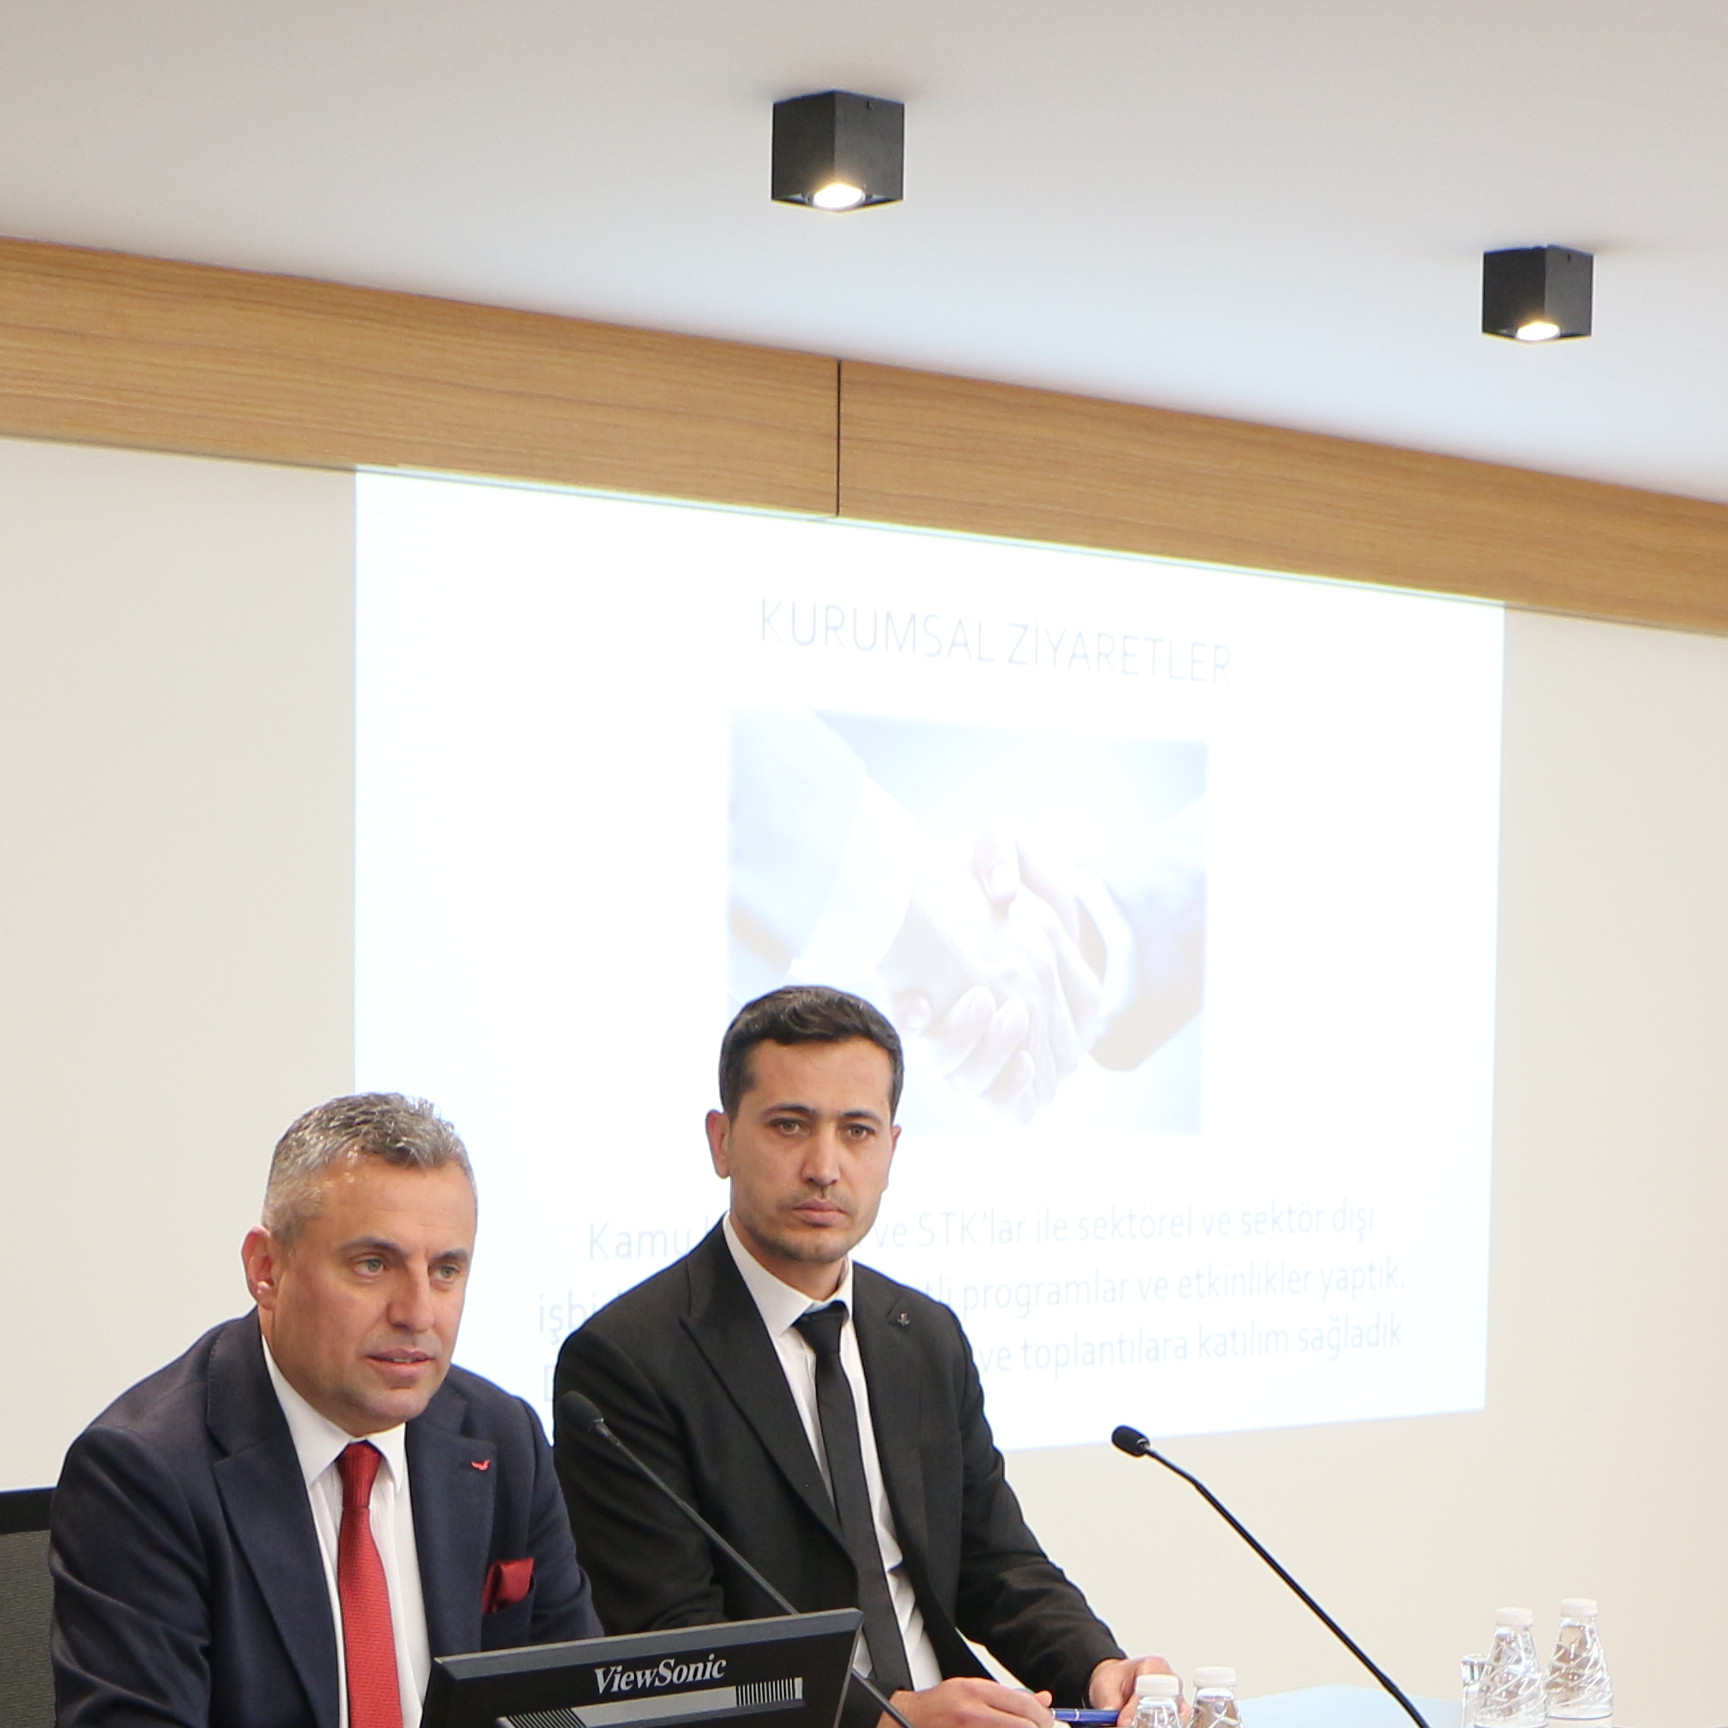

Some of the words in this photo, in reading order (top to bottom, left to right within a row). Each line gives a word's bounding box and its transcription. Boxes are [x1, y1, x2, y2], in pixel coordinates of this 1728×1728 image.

[761, 598, 995, 663] KURUMSAL
[1008, 615, 1231, 684] ZİYARETLER
[874, 1224, 907, 1249] ve
[917, 1209, 1026, 1247] STK'lar
[1036, 1206, 1067, 1244] ile
[1078, 1202, 1191, 1243] sektörel
[1201, 1214, 1232, 1238] ve
[1240, 1200, 1323, 1237] sektör
[1332, 1196, 1374, 1243] dışı
[963, 1265, 1128, 1322] programlar
[1138, 1277, 1168, 1301] ve
[1178, 1258, 1312, 1301] etkinlikler
[1320, 1253, 1406, 1303] yaptık.
[979, 1346, 1012, 1373] ve
[1021, 1326, 1189, 1379] toplantılara
[1199, 1318, 1290, 1359] katılım
[1297, 1310, 1404, 1363] sağladık
[594, 1653, 728, 1695] ViewSonic
